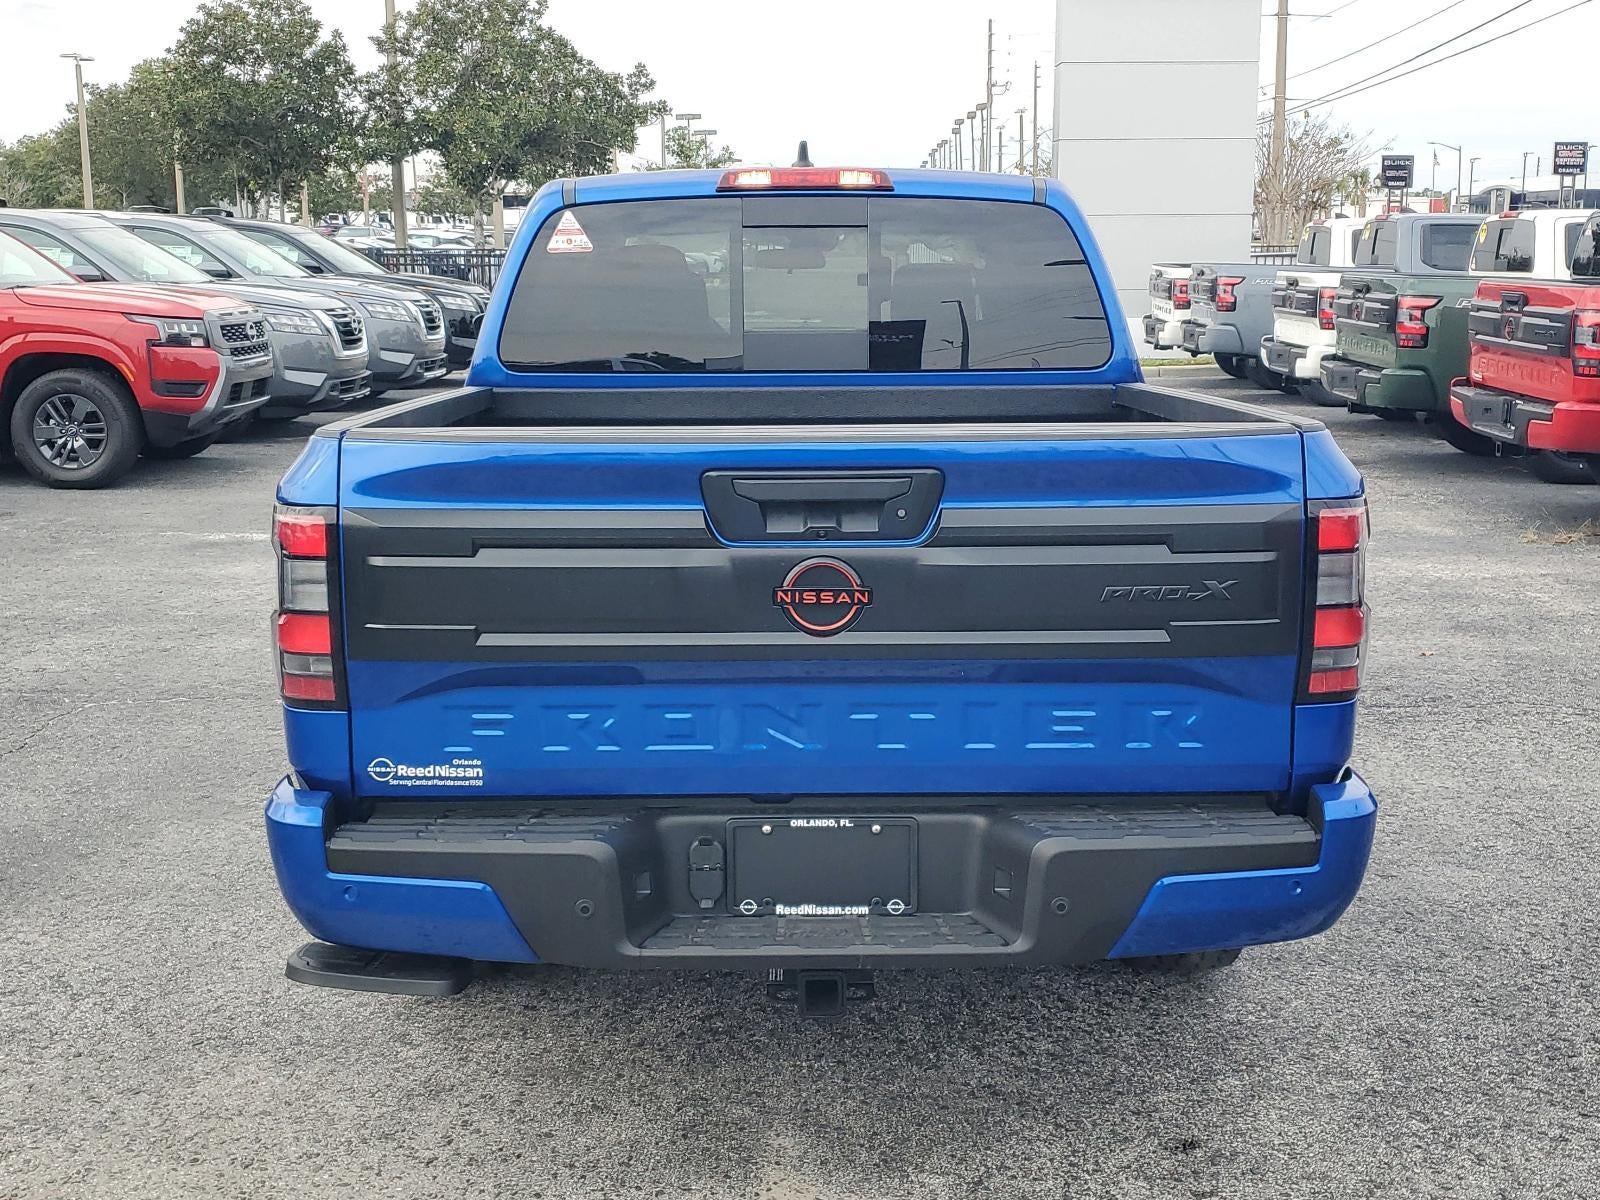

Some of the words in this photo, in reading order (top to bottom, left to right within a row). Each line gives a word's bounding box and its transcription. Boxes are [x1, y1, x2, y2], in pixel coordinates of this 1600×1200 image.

[776, 591, 870, 604] NISSAN
[442, 703, 1204, 753] FRONTIER
[389, 778, 412, 787] Serving
[790, 819, 838, 828] ORLANDO,
[840, 819, 854, 827] FL.
[775, 904, 869, 915] ReedNissan.com
